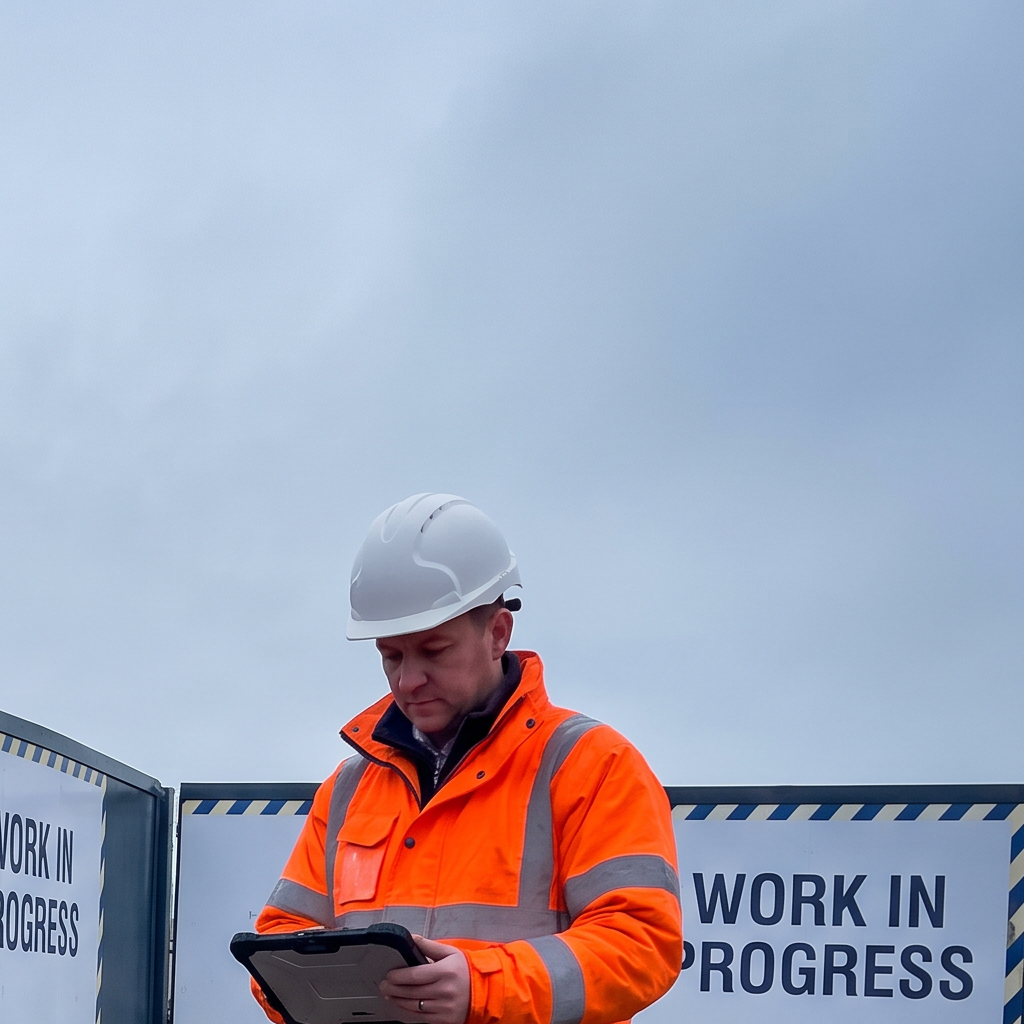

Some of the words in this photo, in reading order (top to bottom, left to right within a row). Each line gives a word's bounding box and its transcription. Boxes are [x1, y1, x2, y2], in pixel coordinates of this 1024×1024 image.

[56, 826, 74, 885] IN
[692, 872, 868, 927] WORK
[888, 874, 946, 929] IN
